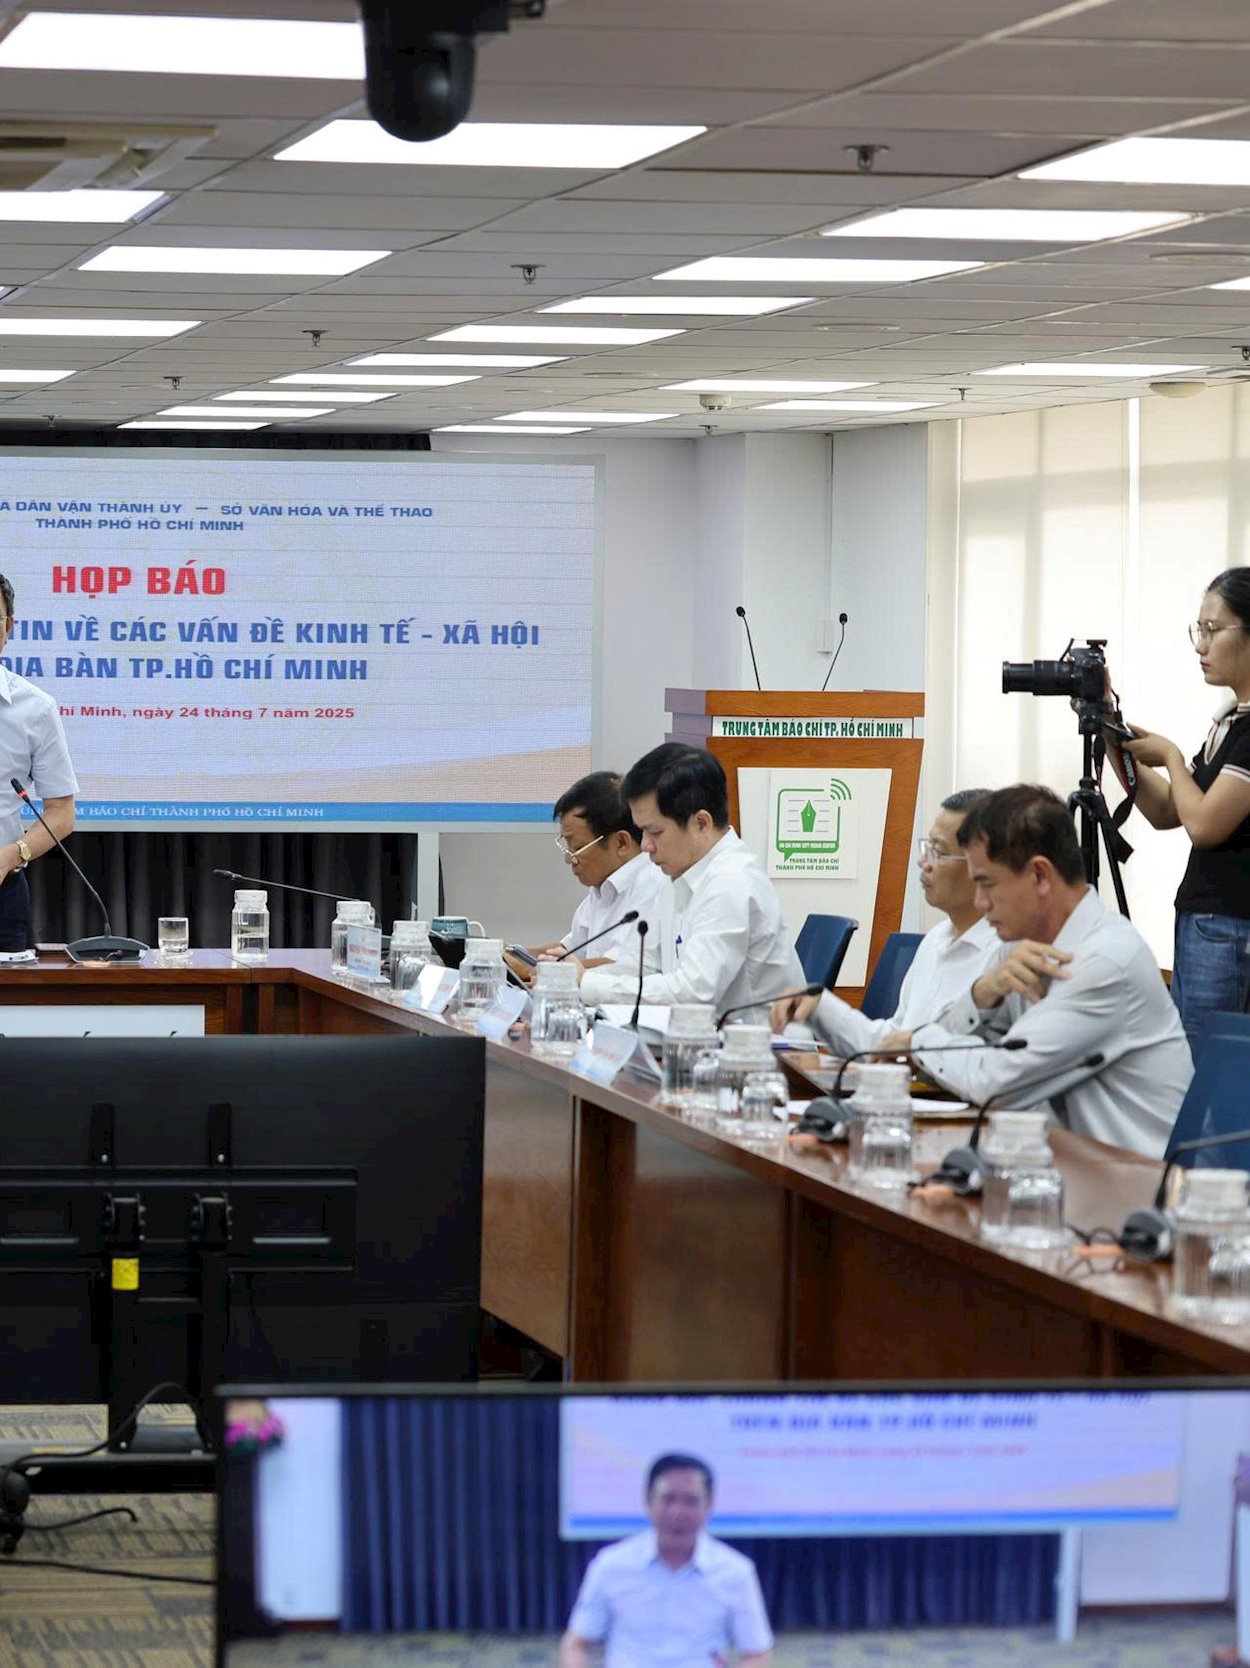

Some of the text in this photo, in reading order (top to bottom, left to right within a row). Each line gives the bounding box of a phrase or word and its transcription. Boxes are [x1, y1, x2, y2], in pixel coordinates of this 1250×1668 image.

[288, 503, 323, 516] HÓA
[327, 504, 349, 517] VÀ
[390, 507, 433, 517] THAO
[36, 516, 244, 531] THÀNH PHỐ HỒ CHÍ MINH
[52, 559, 225, 599] HỌP BÁO
[65, 614, 100, 641] VỀ
[110, 616, 167, 642] CÁC
[178, 616, 238, 642] VẤN
[250, 616, 284, 643] ĐỀ
[296, 622, 368, 644] KINH
[380, 617, 417, 644] TẾ
[443, 619, 480, 645] XÃ
[491, 620, 539, 649] HỘI
[55, 652, 118, 678] BÀN
[128, 652, 214, 679] TP.HỒ
[224, 653, 275, 680] CHÍ
[284, 658, 368, 680] MINH
[59, 706, 355, 720] hí Minh, ngày 24 tháng 7 năm 2025
[721, 720, 756, 736] TRUNG
[758, 718, 780, 736] TÂM
[781, 718, 803, 736] BÁO
[805, 718, 823, 737] CHÍ
[857, 719, 875, 737] CHÍ
[876, 722, 903, 737] MINH
[89, 805, 119, 816] BÁO
[121, 804, 147, 816] CHÍ
[257, 806, 282, 816] CHÍ
[286, 808, 324, 816] MINH
